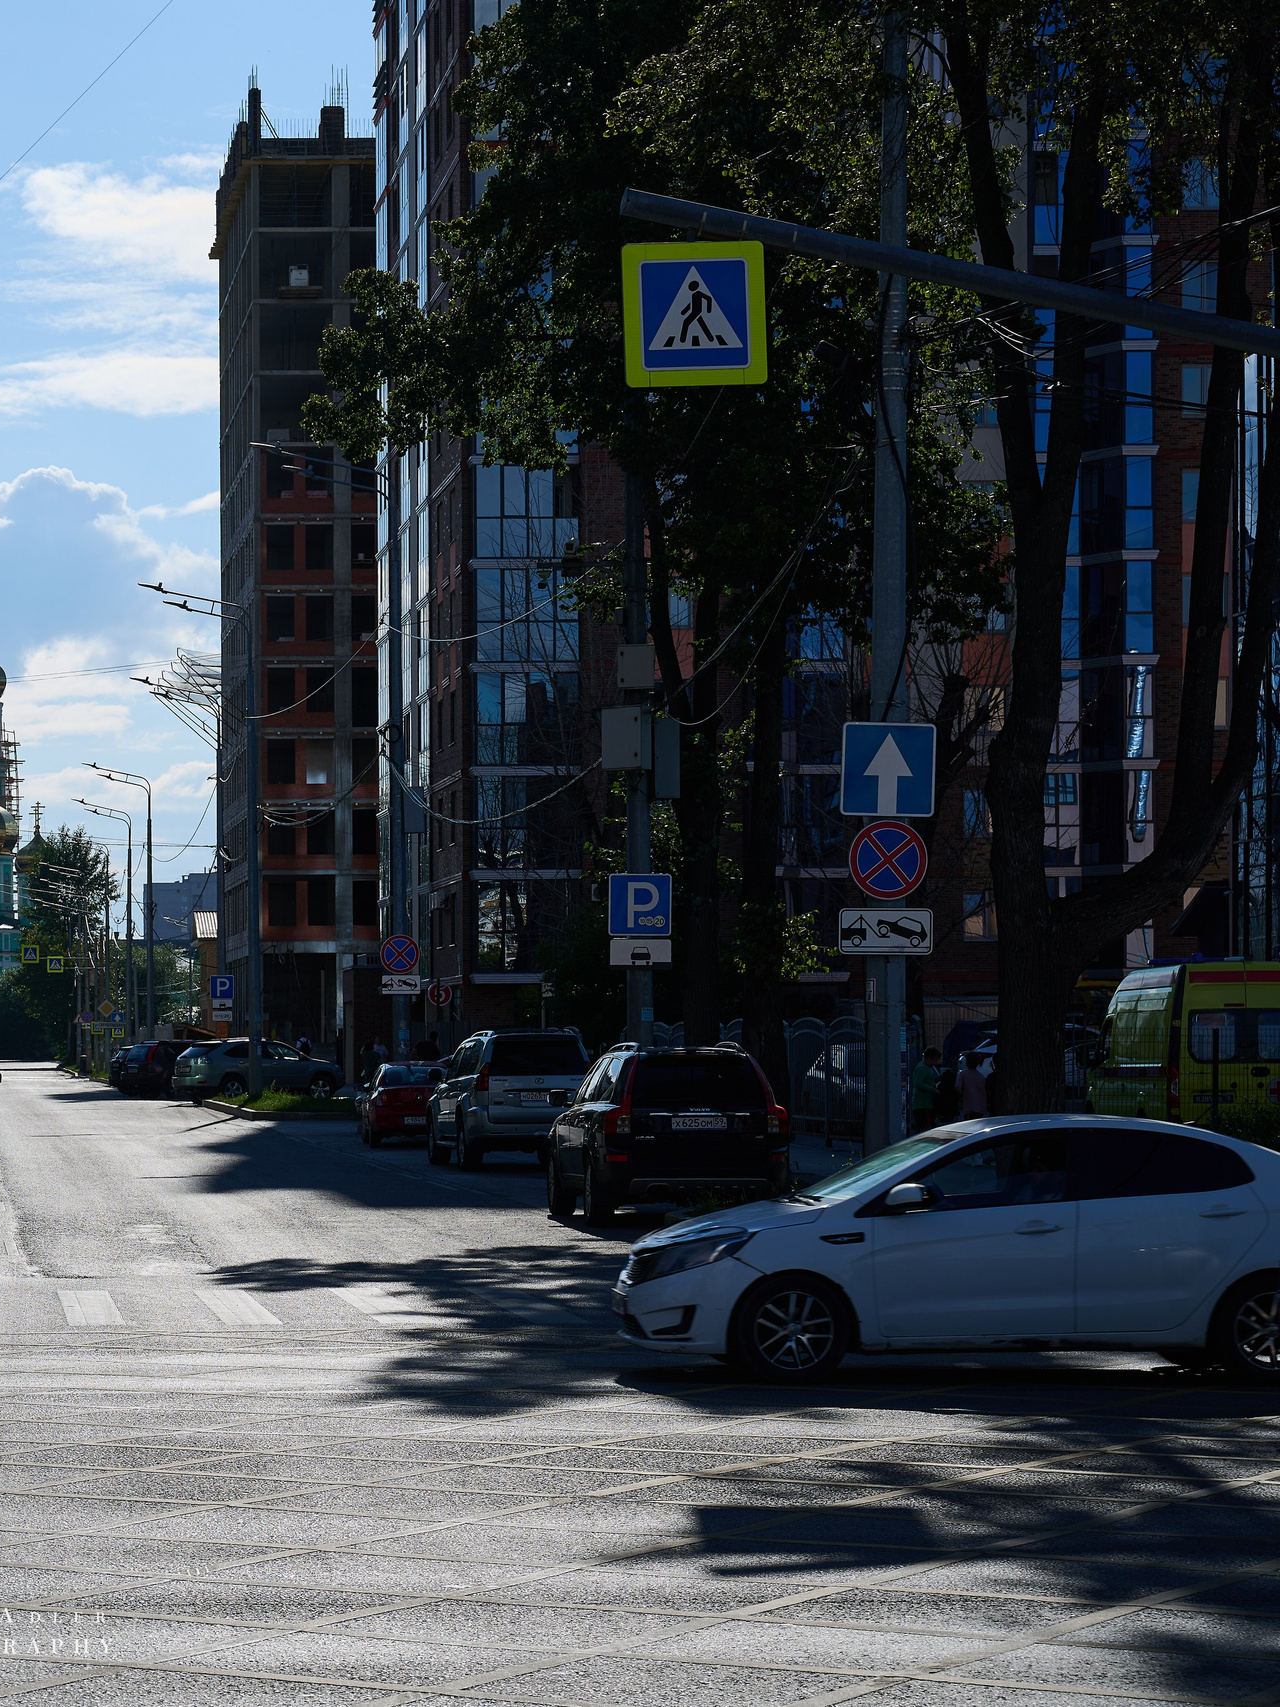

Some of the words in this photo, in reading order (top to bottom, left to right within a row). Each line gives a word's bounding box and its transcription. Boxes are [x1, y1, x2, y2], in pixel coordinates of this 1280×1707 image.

[627, 881, 660, 928] P
[654, 917, 665, 926] 20
[216, 977, 230, 997] P
